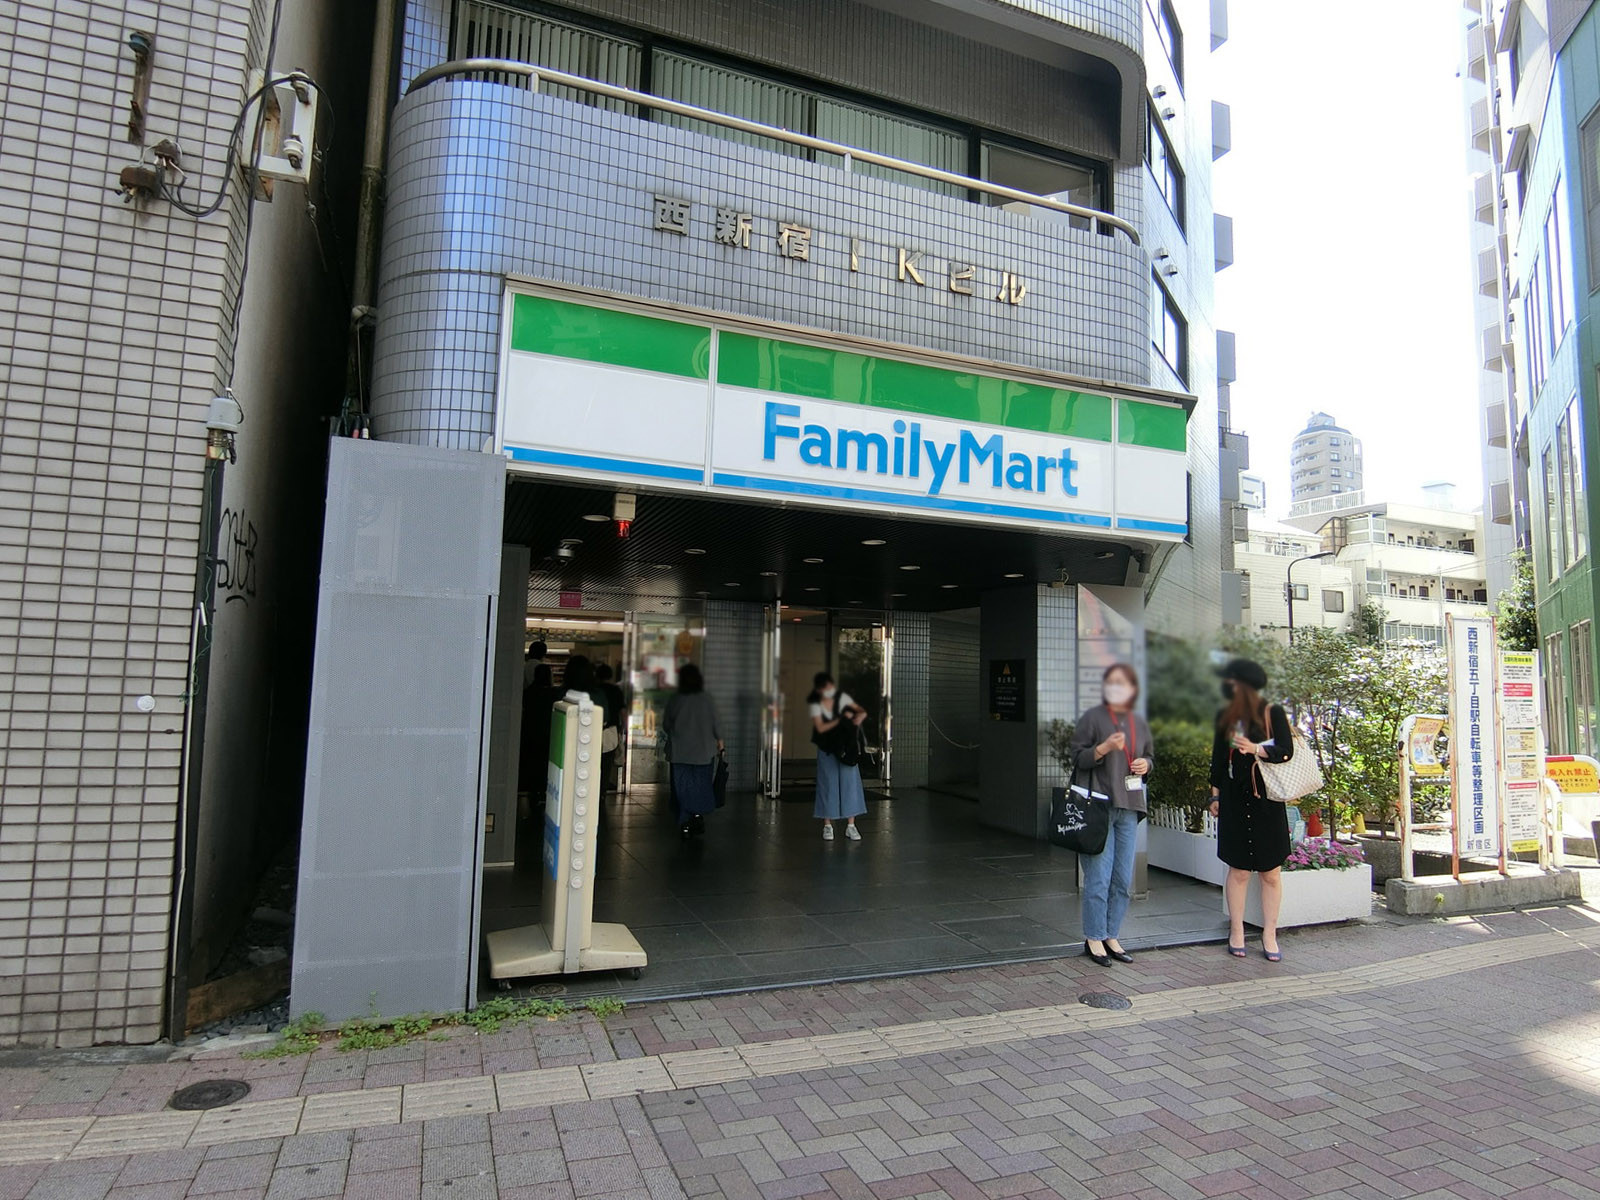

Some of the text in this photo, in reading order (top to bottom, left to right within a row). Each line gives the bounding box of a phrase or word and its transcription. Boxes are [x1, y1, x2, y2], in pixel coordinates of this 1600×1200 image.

[762, 401, 1079, 497] FamilyMart
[1467, 627, 1484, 834] 西新宿五丁目駅自転車等整理区画
[1467, 838, 1491, 850] 新宿区
